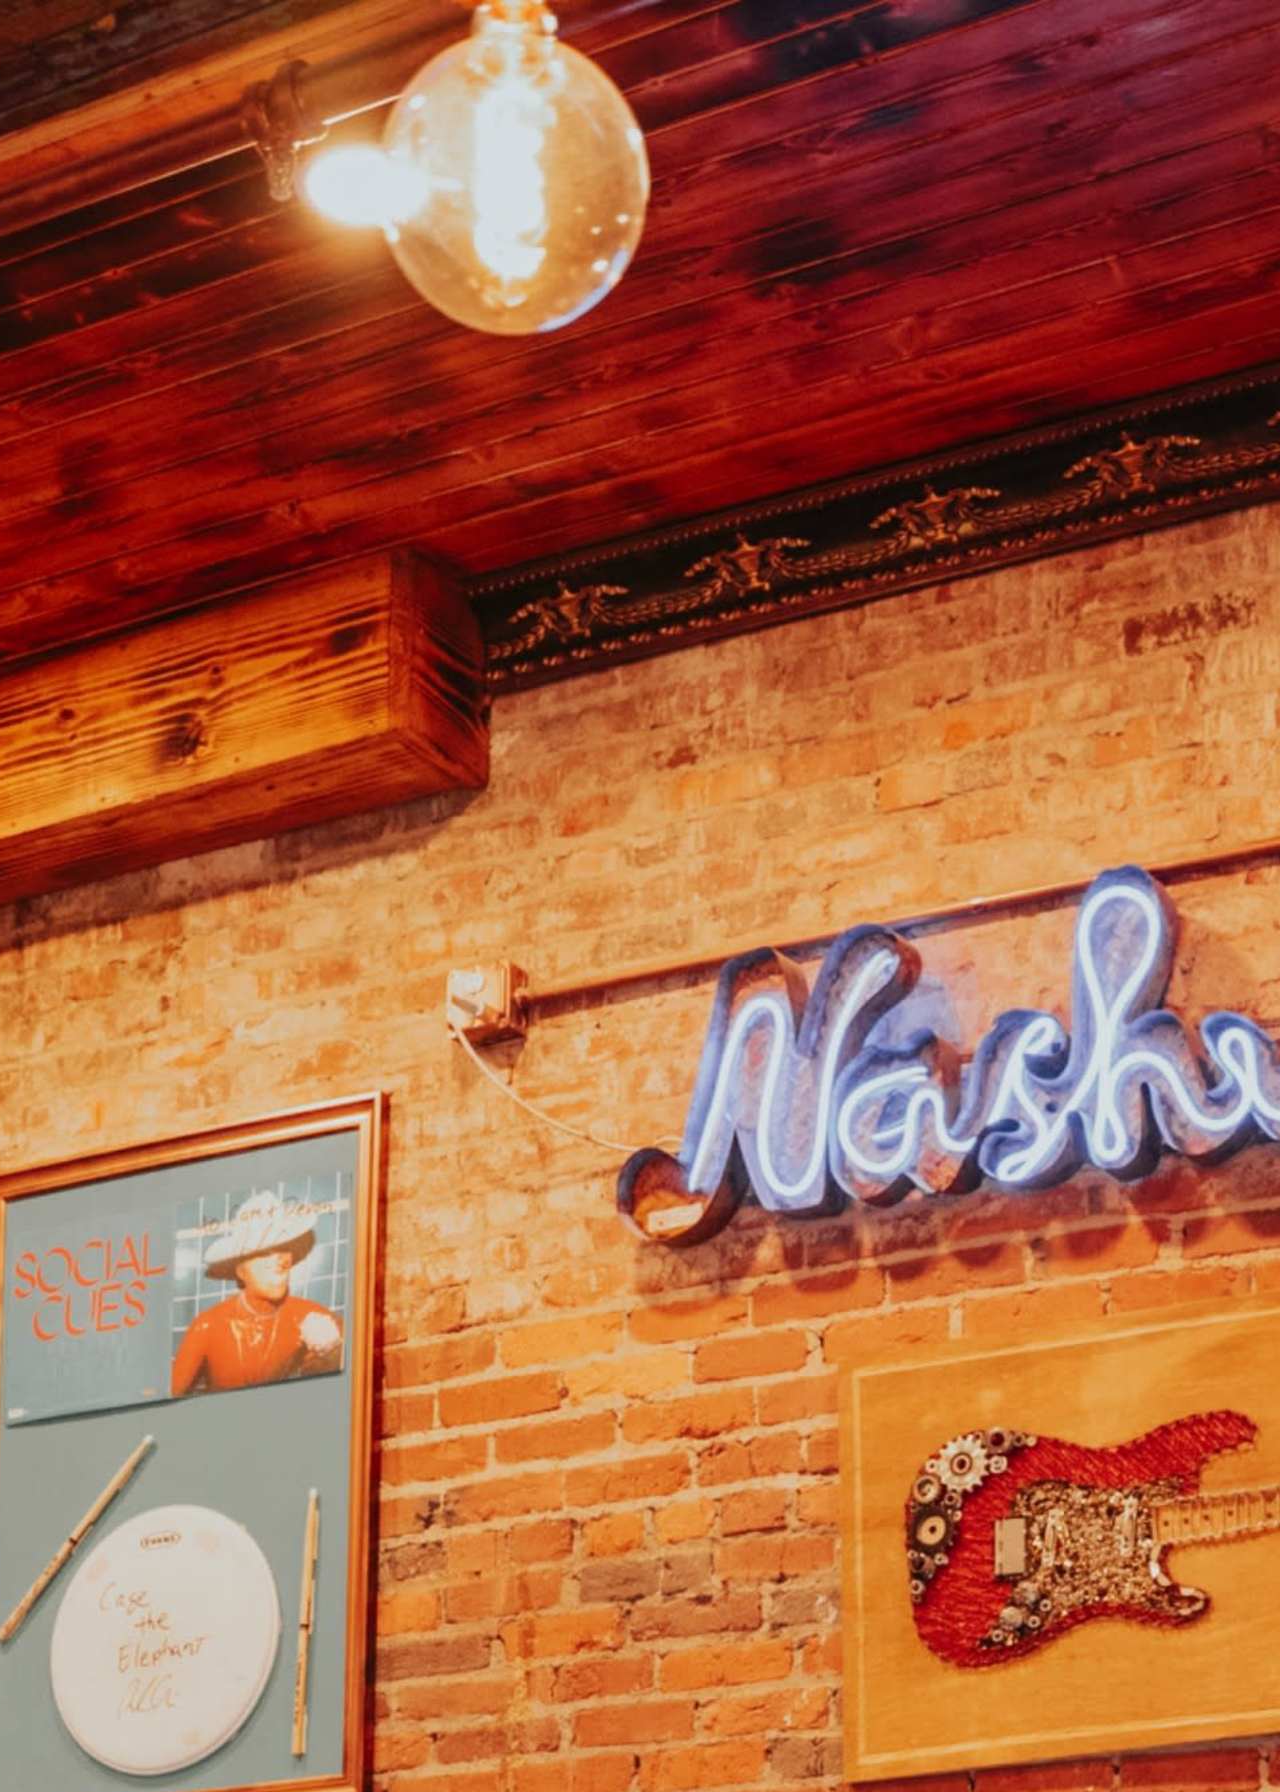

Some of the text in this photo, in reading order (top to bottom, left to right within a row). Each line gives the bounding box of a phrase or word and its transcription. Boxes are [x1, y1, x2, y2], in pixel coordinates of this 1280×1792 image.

[14, 1232, 168, 1298] SOCIAL
[33, 1280, 146, 1340] CUES
[135, 1611, 170, 1630] the
